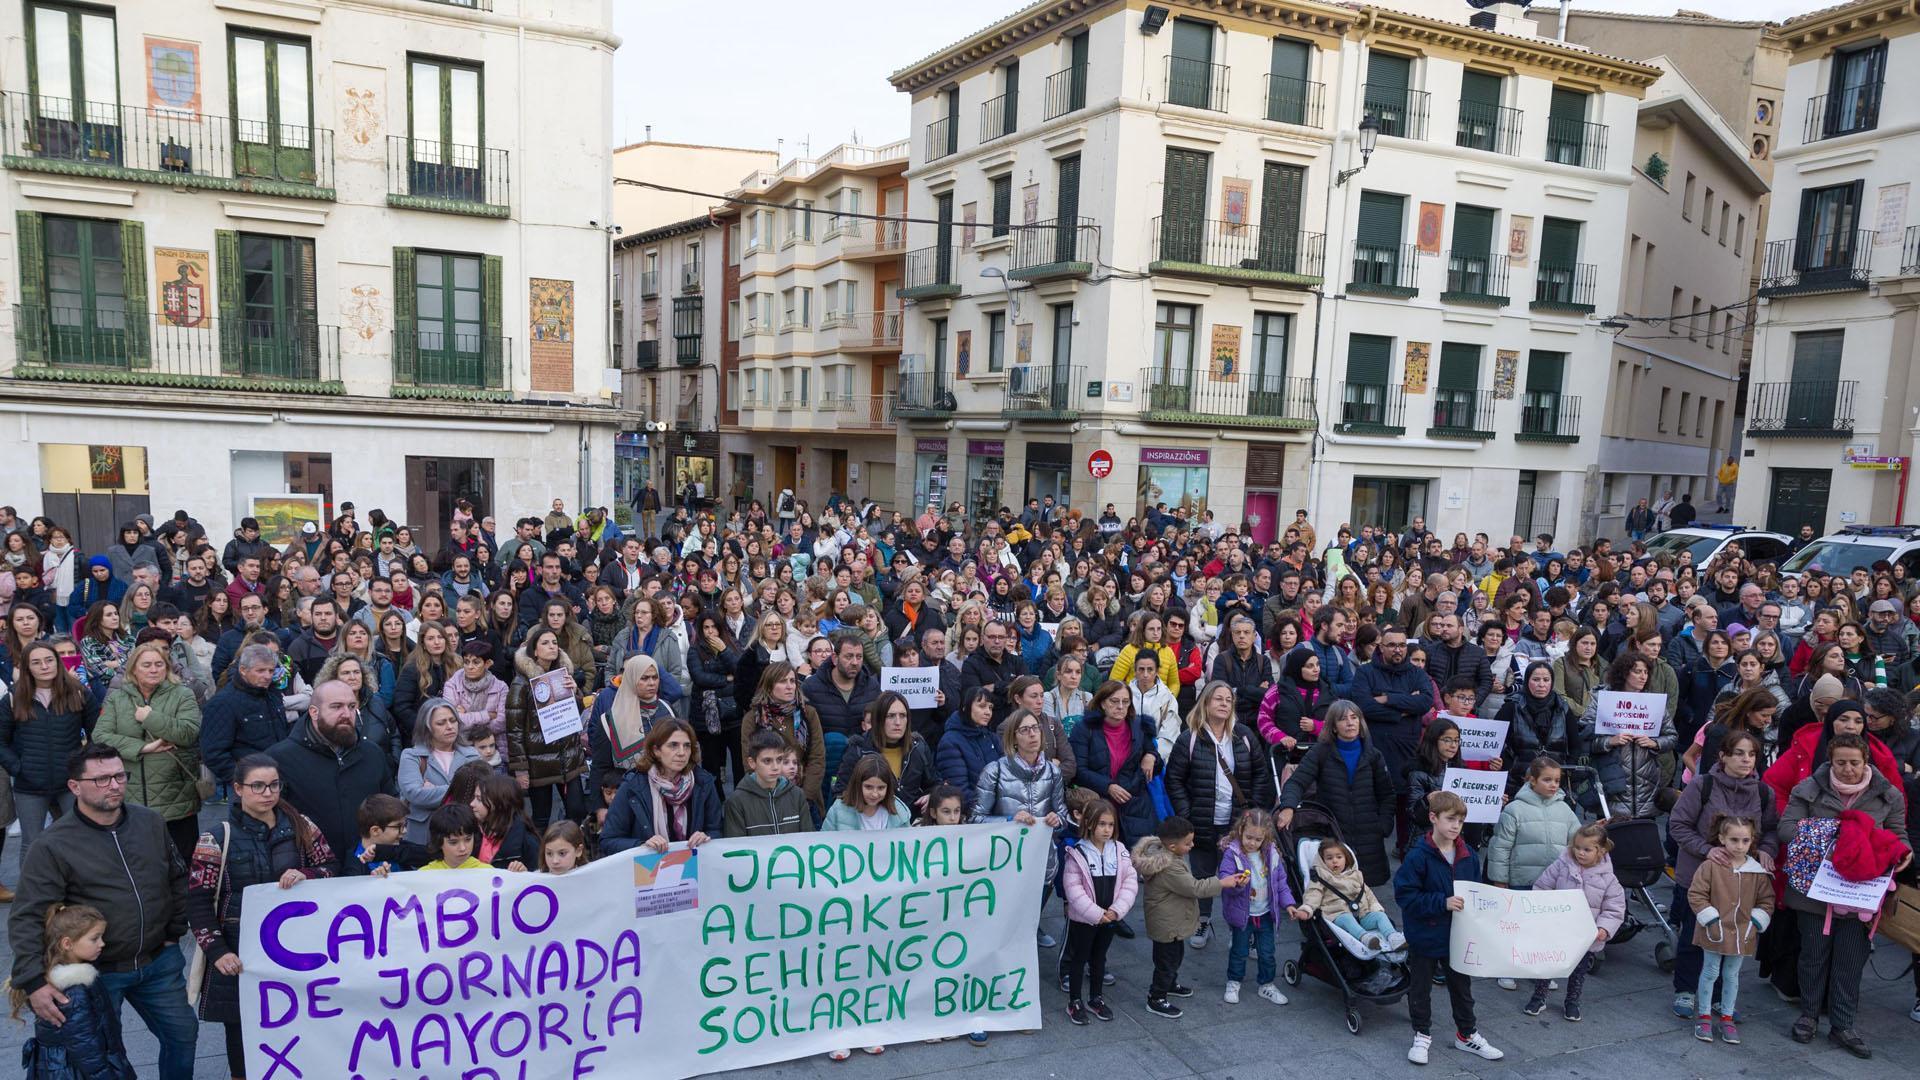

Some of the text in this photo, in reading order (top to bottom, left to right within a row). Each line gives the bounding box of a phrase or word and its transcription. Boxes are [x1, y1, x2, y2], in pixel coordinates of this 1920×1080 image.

[1462, 780, 1499, 792] RECURSOS!
[702, 877, 997, 945] ALDAKETA
[1502, 894, 1514, 913] Y
[1463, 941, 1567, 967] EL ALUMNADO
[259, 929, 641, 1029] DE JORNADA
[259, 1035, 303, 1080] X
